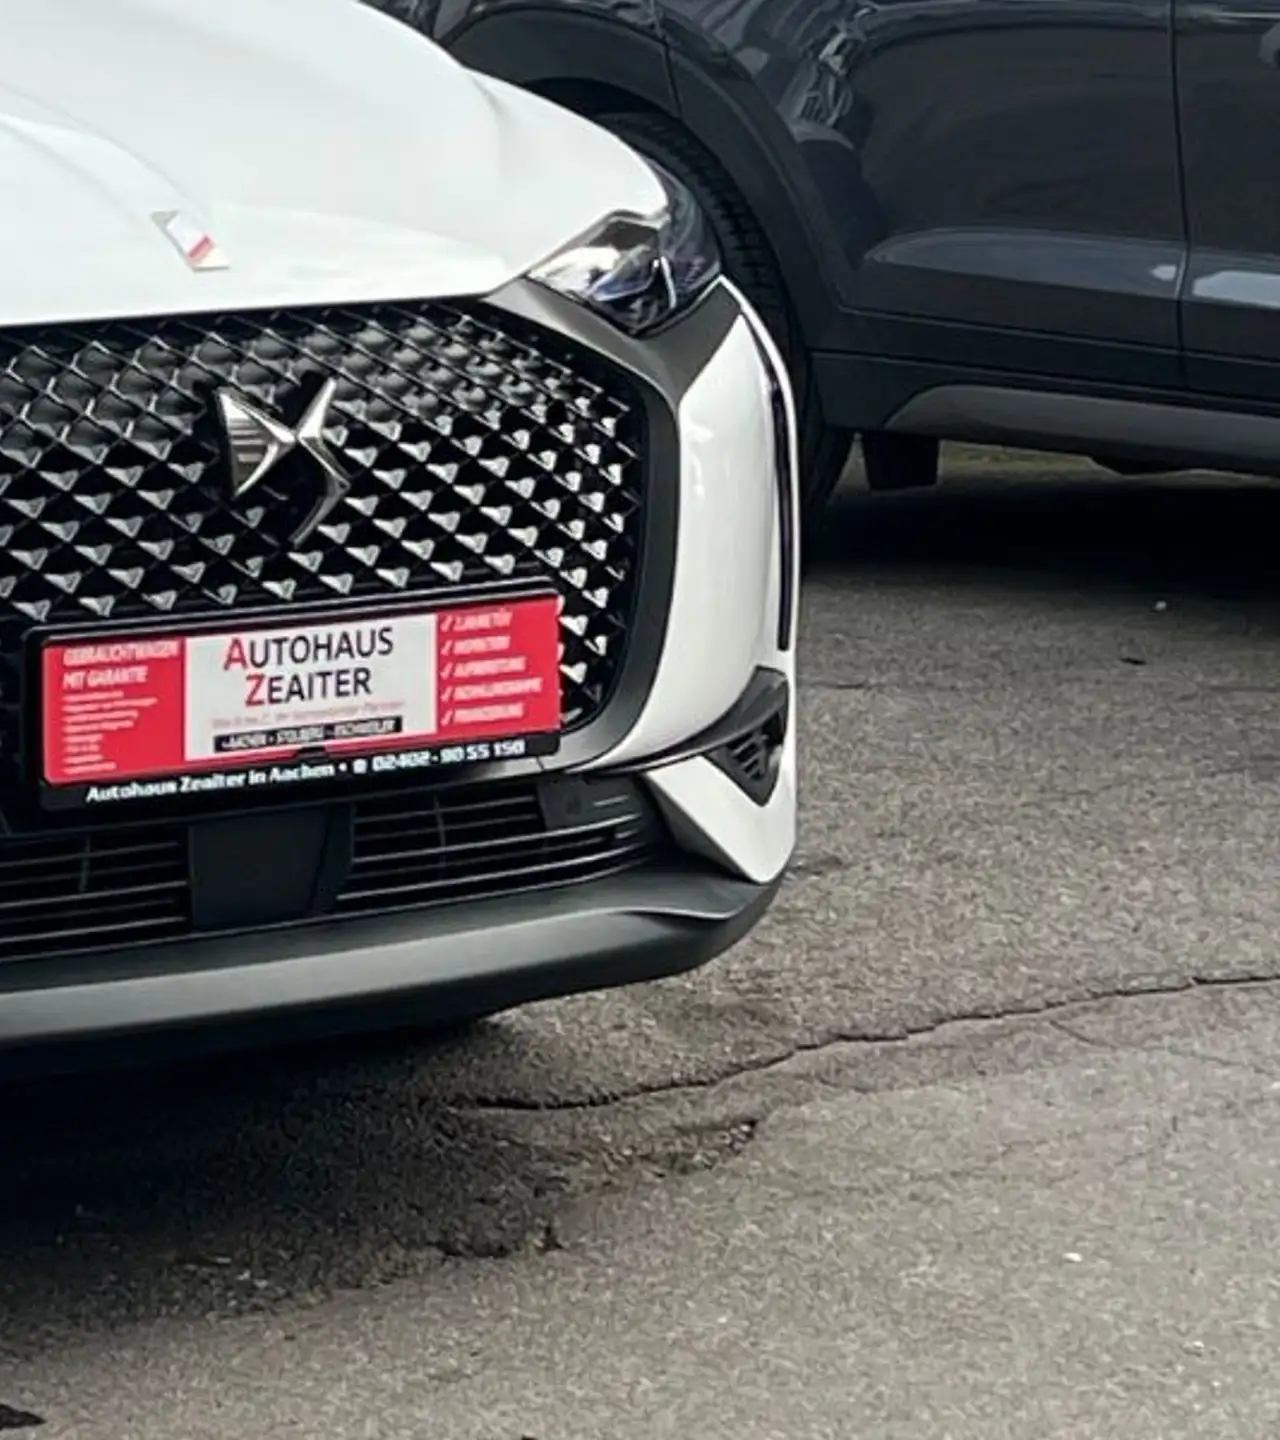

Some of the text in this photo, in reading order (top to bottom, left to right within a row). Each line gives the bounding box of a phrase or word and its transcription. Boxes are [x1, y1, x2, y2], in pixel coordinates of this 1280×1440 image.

[223, 626, 393, 671] AUTOHAUS
[245, 667, 373, 707] ZEAITER
[85, 780, 178, 803] Autohaus
[179, 771, 247, 794] Zeaiter
[249, 769, 267, 785] in
[269, 762, 335, 782] Aachen
